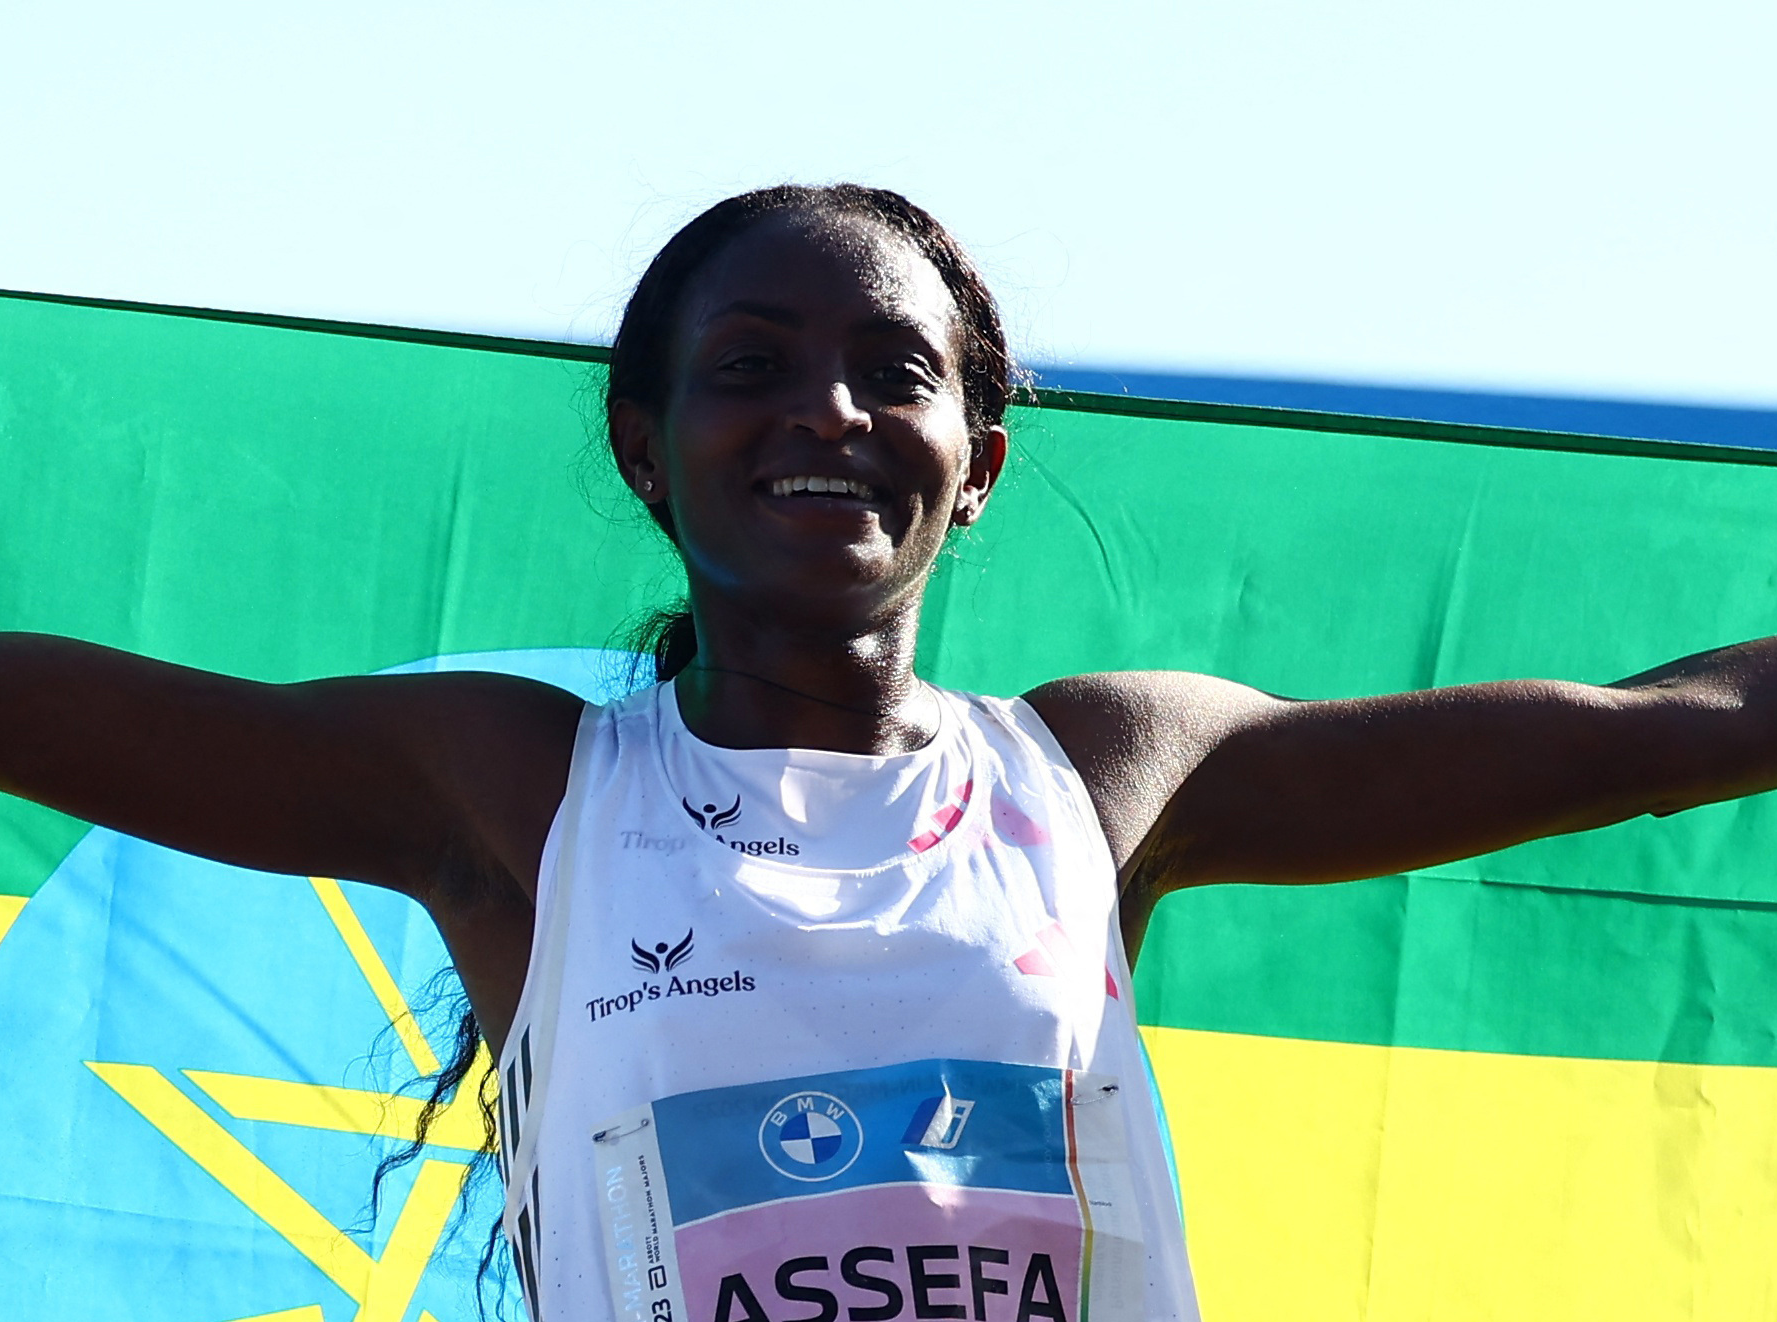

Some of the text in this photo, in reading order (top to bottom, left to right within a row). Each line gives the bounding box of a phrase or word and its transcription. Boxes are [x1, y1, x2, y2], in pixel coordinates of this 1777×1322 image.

[586, 970, 756, 1022] Tirop's Angels
[770, 1096, 845, 1127] BMW
[638, 1155, 661, 1262] WORLD MARATHON MAJORS
